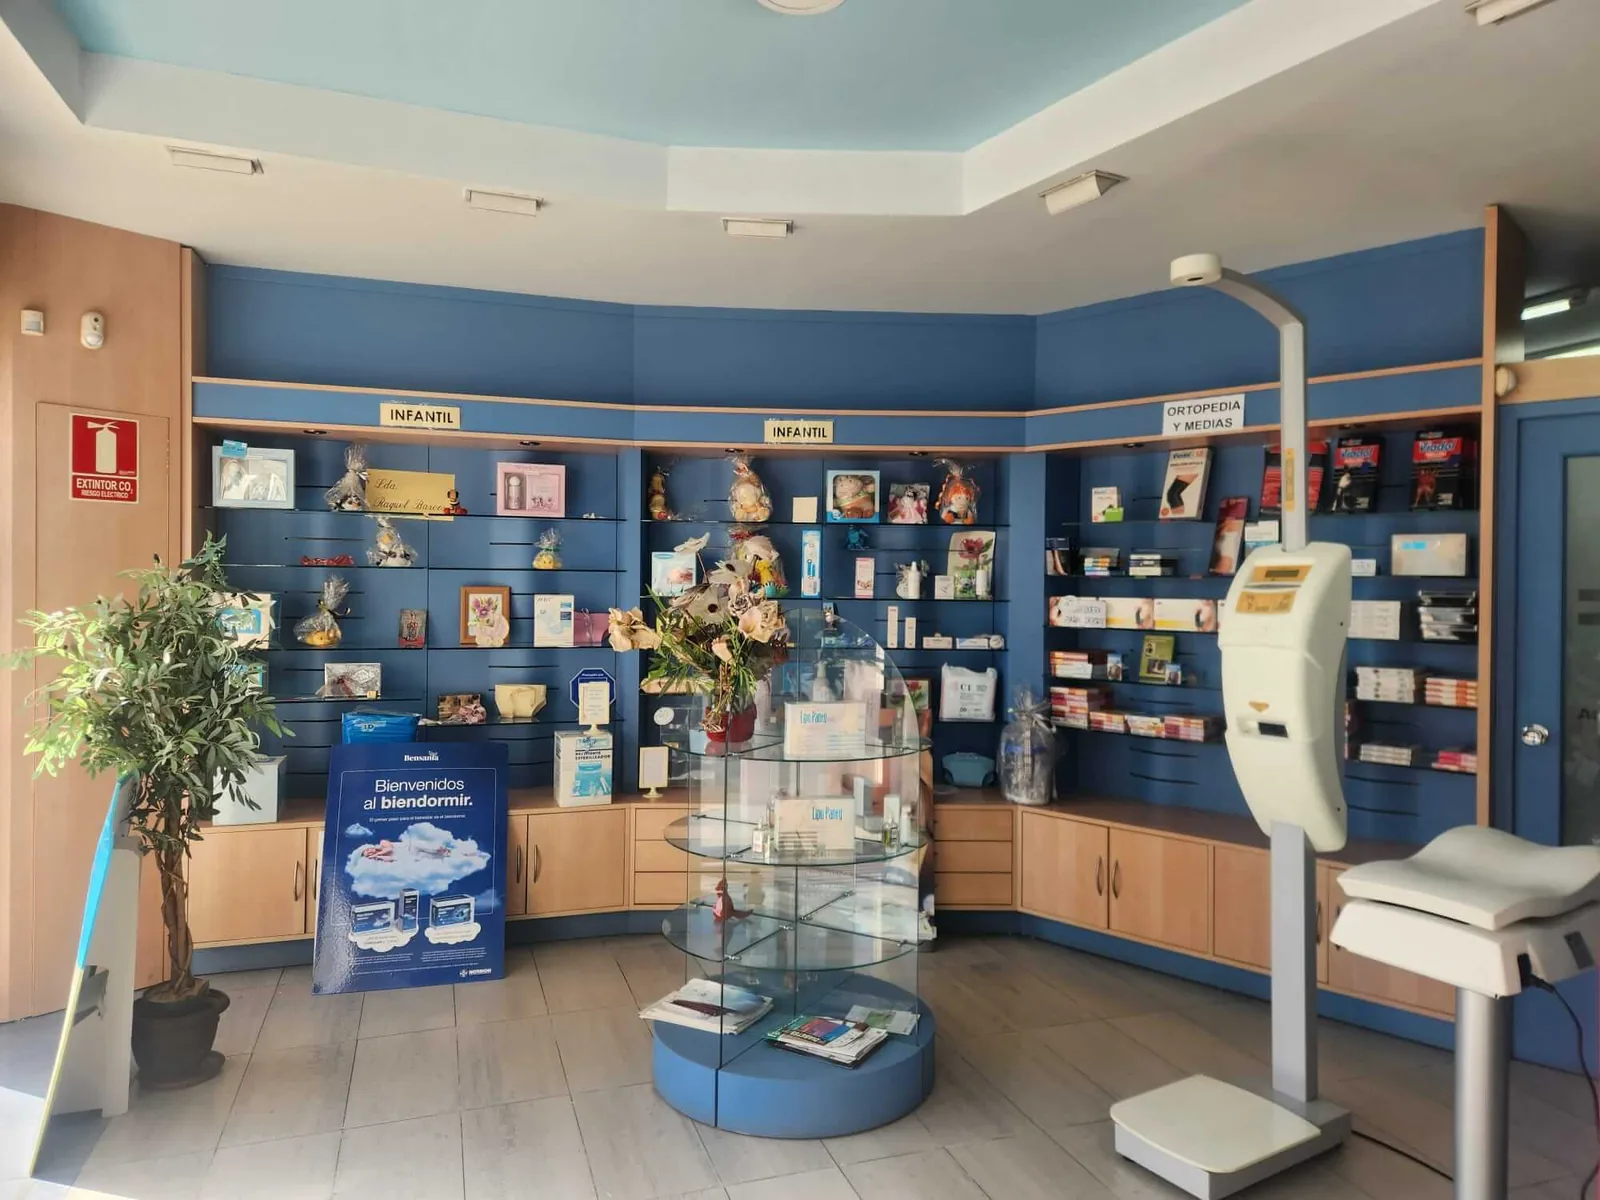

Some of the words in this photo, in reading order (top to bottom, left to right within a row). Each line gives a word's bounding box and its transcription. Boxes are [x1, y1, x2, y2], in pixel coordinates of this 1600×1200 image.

[390, 409, 454, 423] INFANTIL
[1167, 401, 1241, 417] ORTOPEDIA
[1173, 422, 1181, 432] Y
[1185, 418, 1233, 432] MEDIAS
[773, 427, 828, 438] INFANTIL
[76, 478, 117, 491] EXTINTOR
[81, 489, 101, 497] RIESGO
[375, 778, 465, 793] Bienvenidos
[363, 796, 377, 810] al
[380, 794, 473, 809] biendormir.
